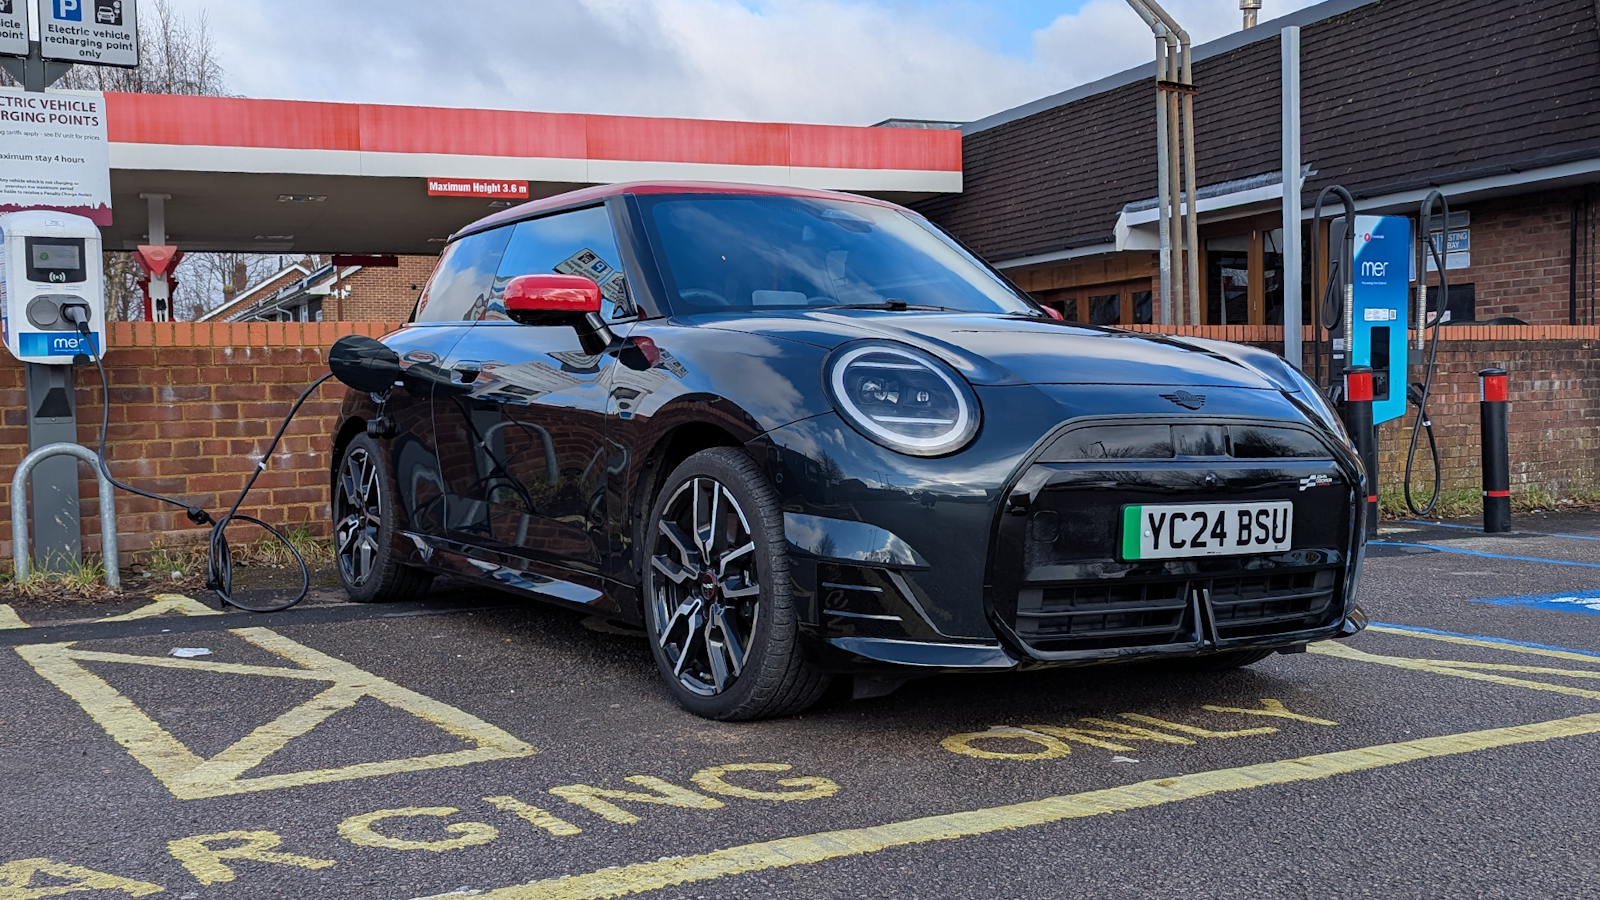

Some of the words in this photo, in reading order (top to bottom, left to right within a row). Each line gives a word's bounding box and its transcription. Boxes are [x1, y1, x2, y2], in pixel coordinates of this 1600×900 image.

[60, 0, 77, 17] P
[48, 24, 90, 36] Electric
[93, 30, 130, 40] vehicle
[45, 36, 102, 49] recharging
[106, 42, 133, 51] point
[79, 48, 101, 59] only
[40, 99, 96, 112] VEHICLE
[49, 114, 99, 126] POINTS
[35, 155, 52, 163] stay
[61, 155, 85, 163] hours
[429, 182, 471, 192] Maximum
[473, 182, 500, 194] Height
[502, 184, 517, 193] 3.6
[1362, 262, 1389, 276] mer
[54, 338, 84, 348] mer
[1148, 511, 1227, 550] YC24
[1236, 508, 1288, 546] BSU
[0, 762, 841, 900] ARGING
[938, 698, 1339, 760] ONLY
